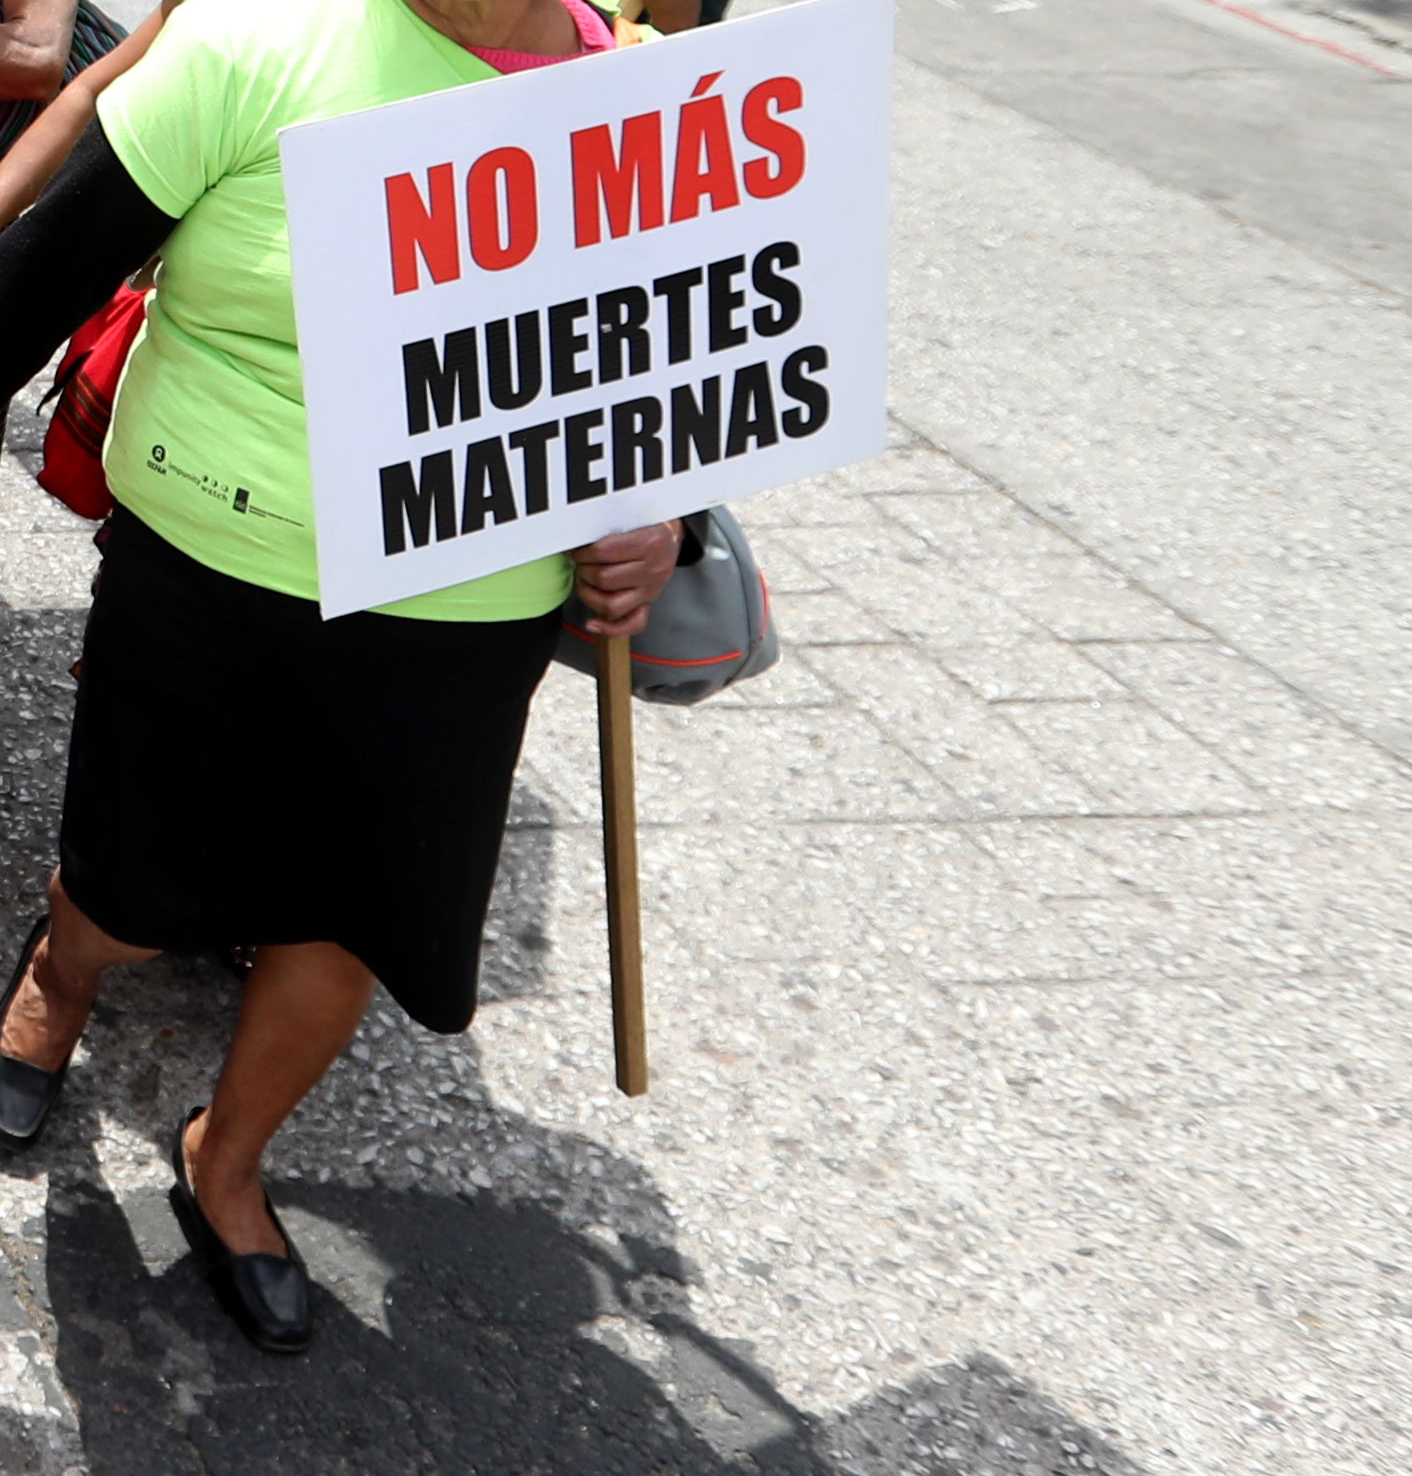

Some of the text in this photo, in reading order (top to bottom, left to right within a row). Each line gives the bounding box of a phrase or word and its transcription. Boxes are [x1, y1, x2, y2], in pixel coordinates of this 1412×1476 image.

[383, 69, 806, 296] NO MÁS
[400, 239, 802, 437] MUERTES
[200, 485, 228, 502] watch
[377, 344, 830, 557] MATERNAS
